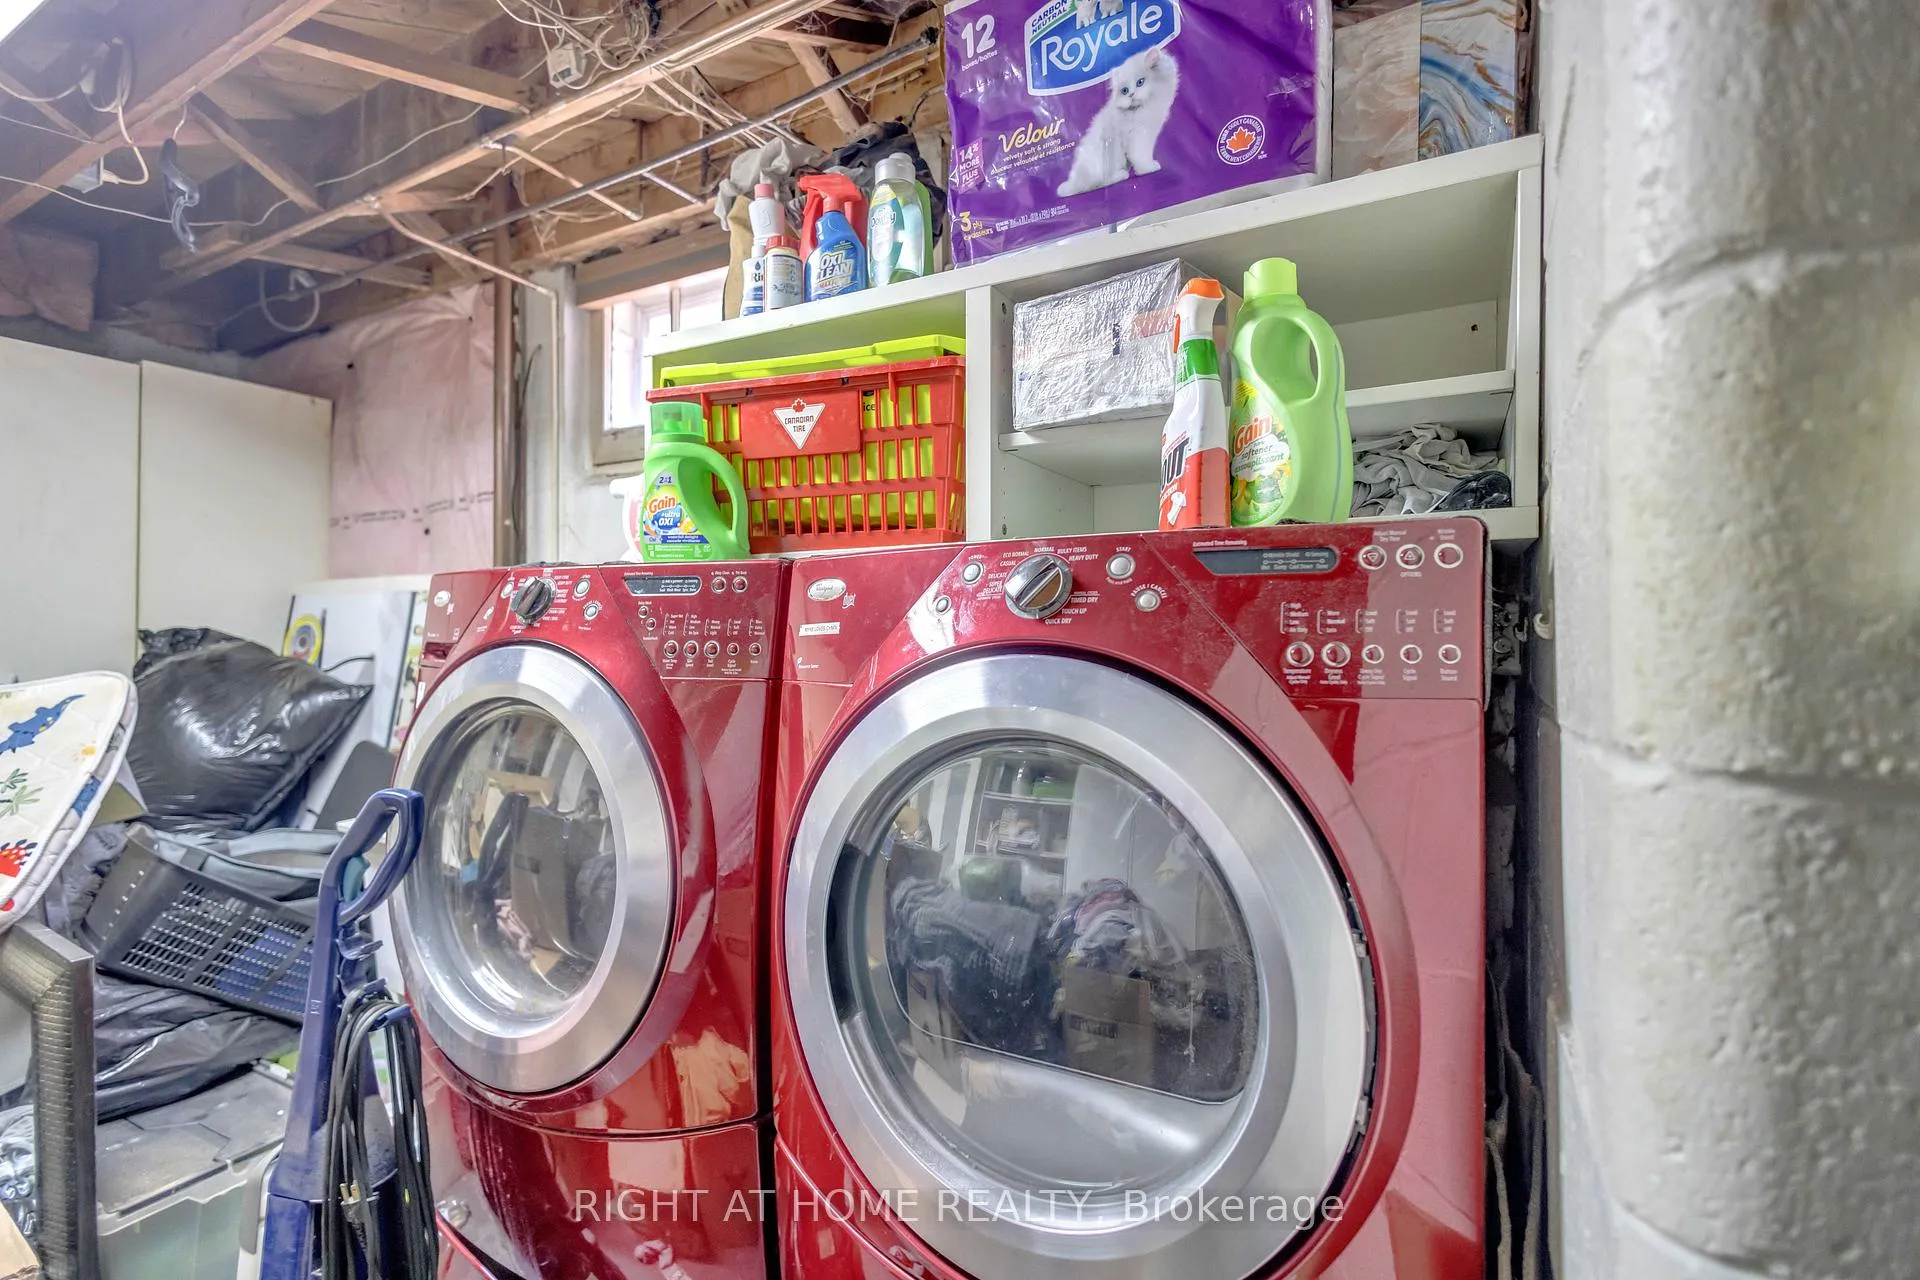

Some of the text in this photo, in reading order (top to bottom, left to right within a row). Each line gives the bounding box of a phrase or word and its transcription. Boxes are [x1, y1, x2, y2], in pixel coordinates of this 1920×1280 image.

[1031, 0, 1068, 27] CARBON
[1032, 7, 1067, 36] NEUTRAL
[961, 14, 996, 59] 12
[1041, 1, 1163, 77] Royale
[998, 116, 1065, 153] Velour
[959, 142, 979, 163] 14%
[959, 155, 980, 172] MORE
[961, 169, 979, 183] PLUS
[959, 211, 972, 232] 3
[972, 219, 983, 230] ply
[820, 253, 847, 274] OXI
[753, 272, 763, 283] Ri
[785, 415, 814, 425] CANADIAN
[793, 425, 805, 433] TIRE
[1234, 416, 1272, 455] Gain
[1241, 444, 1273, 460] softener
[649, 496, 676, 513] Gain
[658, 518, 674, 526] OXI
